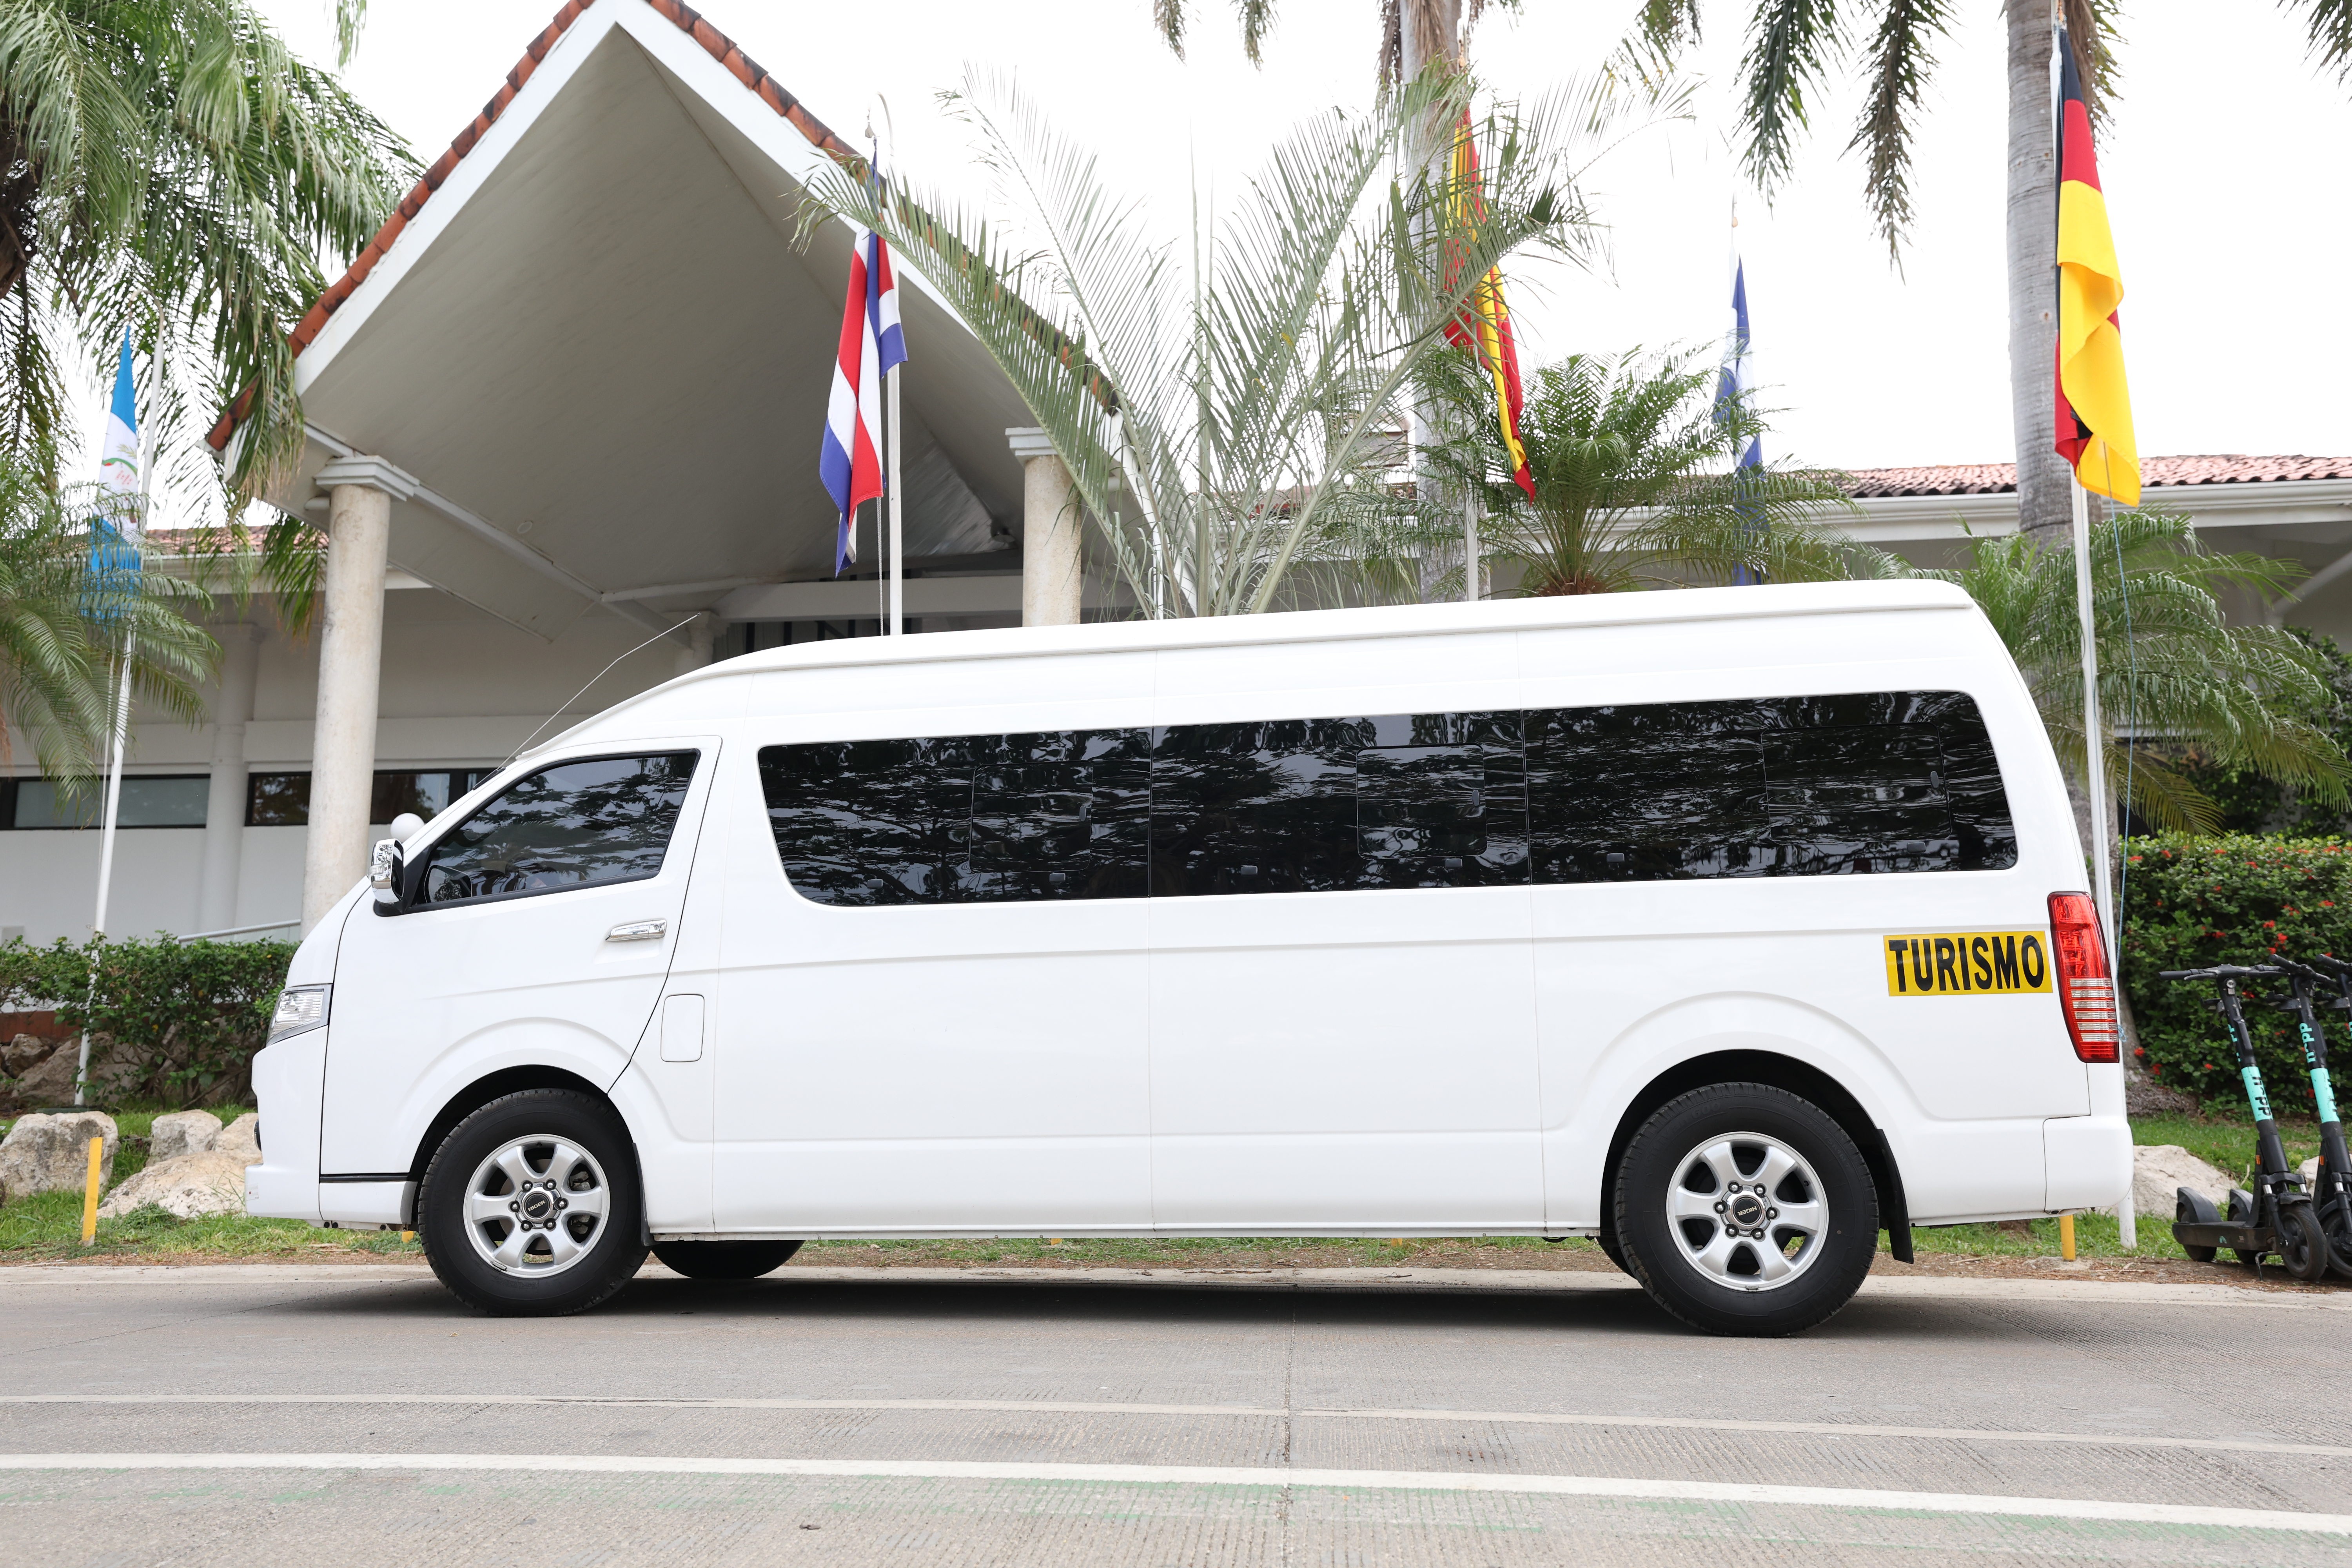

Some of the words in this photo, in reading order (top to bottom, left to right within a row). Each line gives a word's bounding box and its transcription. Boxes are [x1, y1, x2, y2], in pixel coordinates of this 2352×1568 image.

[1889, 935, 2043, 992] TURISMO
[528, 1200, 545, 1211] HIGER
[1737, 1206, 1757, 1216] HIGER
